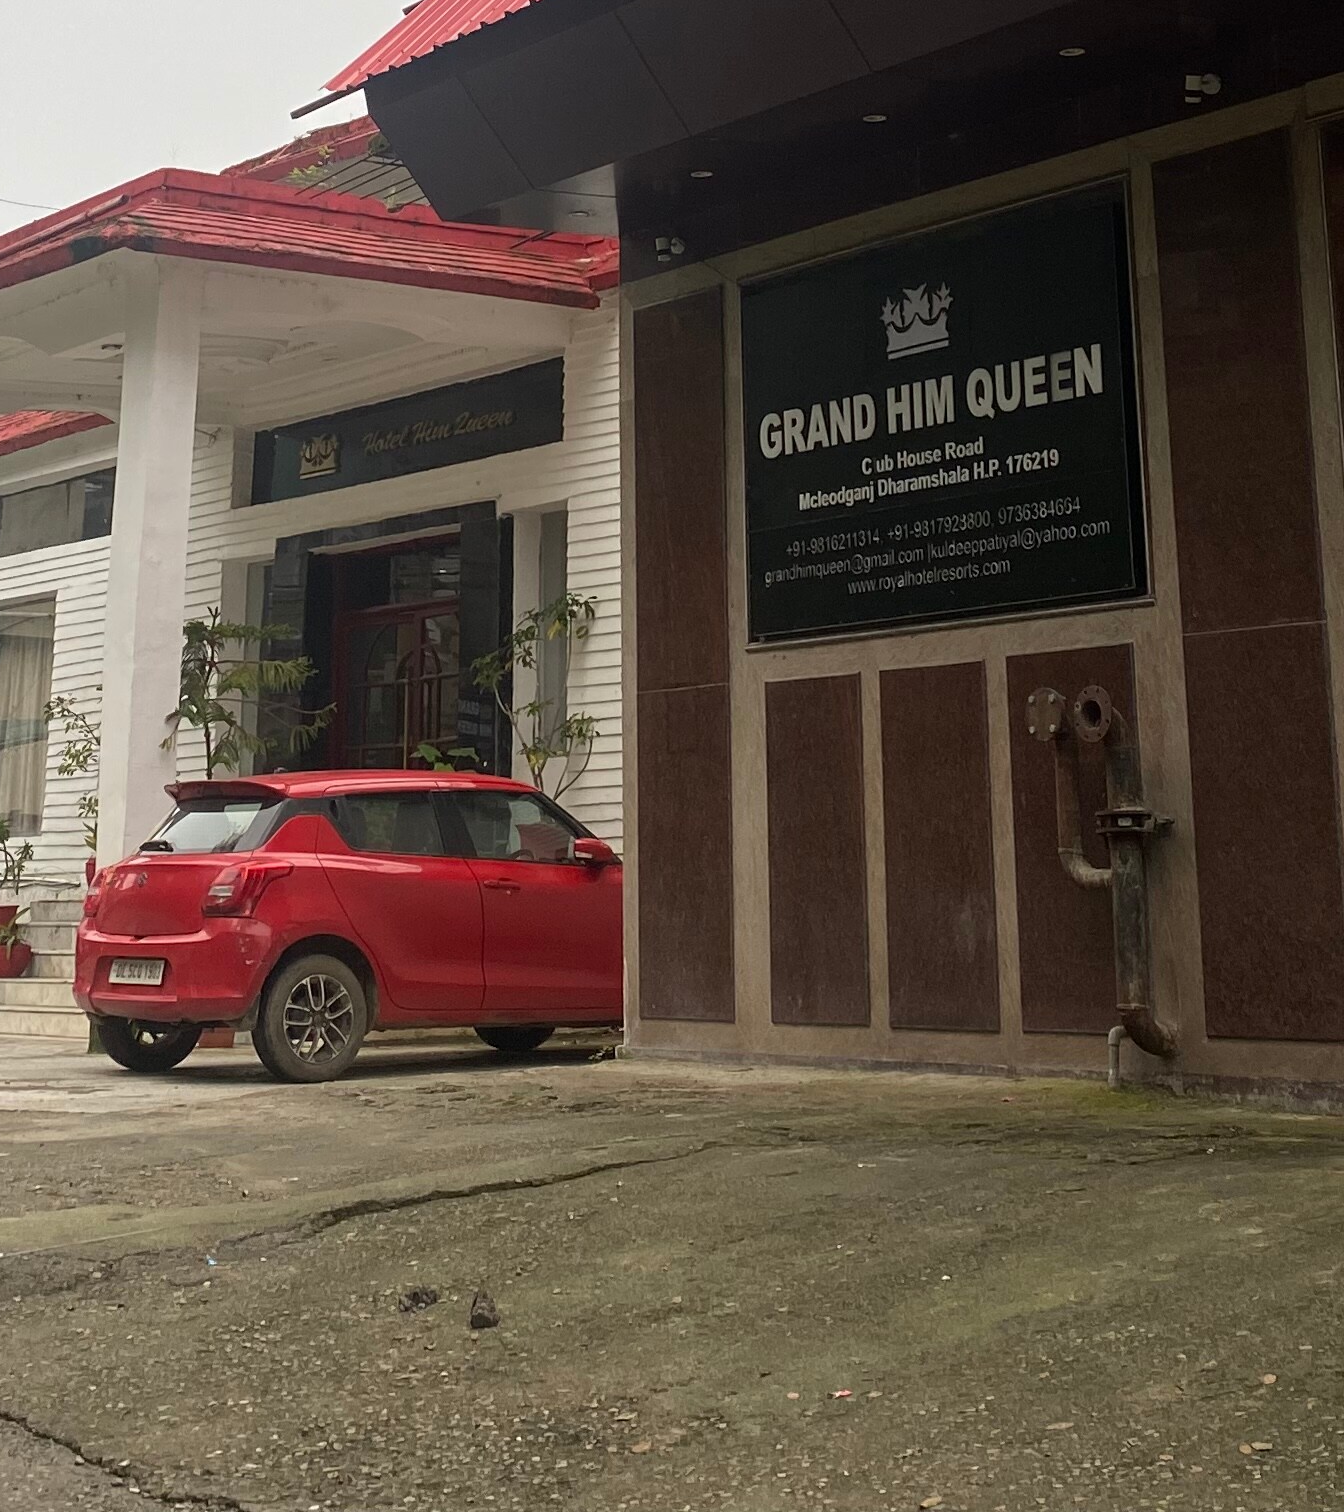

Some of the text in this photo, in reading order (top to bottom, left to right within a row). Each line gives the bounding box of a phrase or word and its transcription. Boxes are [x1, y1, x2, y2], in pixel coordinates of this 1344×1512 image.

[759, 343, 1104, 460] GRAND HIM QUEEN
[798, 448, 1060, 511] Mcleodganj Dharamshala H.P. 176219
[861, 436, 985, 476] Cub House Road
[764, 548, 924, 588] grandhimqueen@gmail.com
